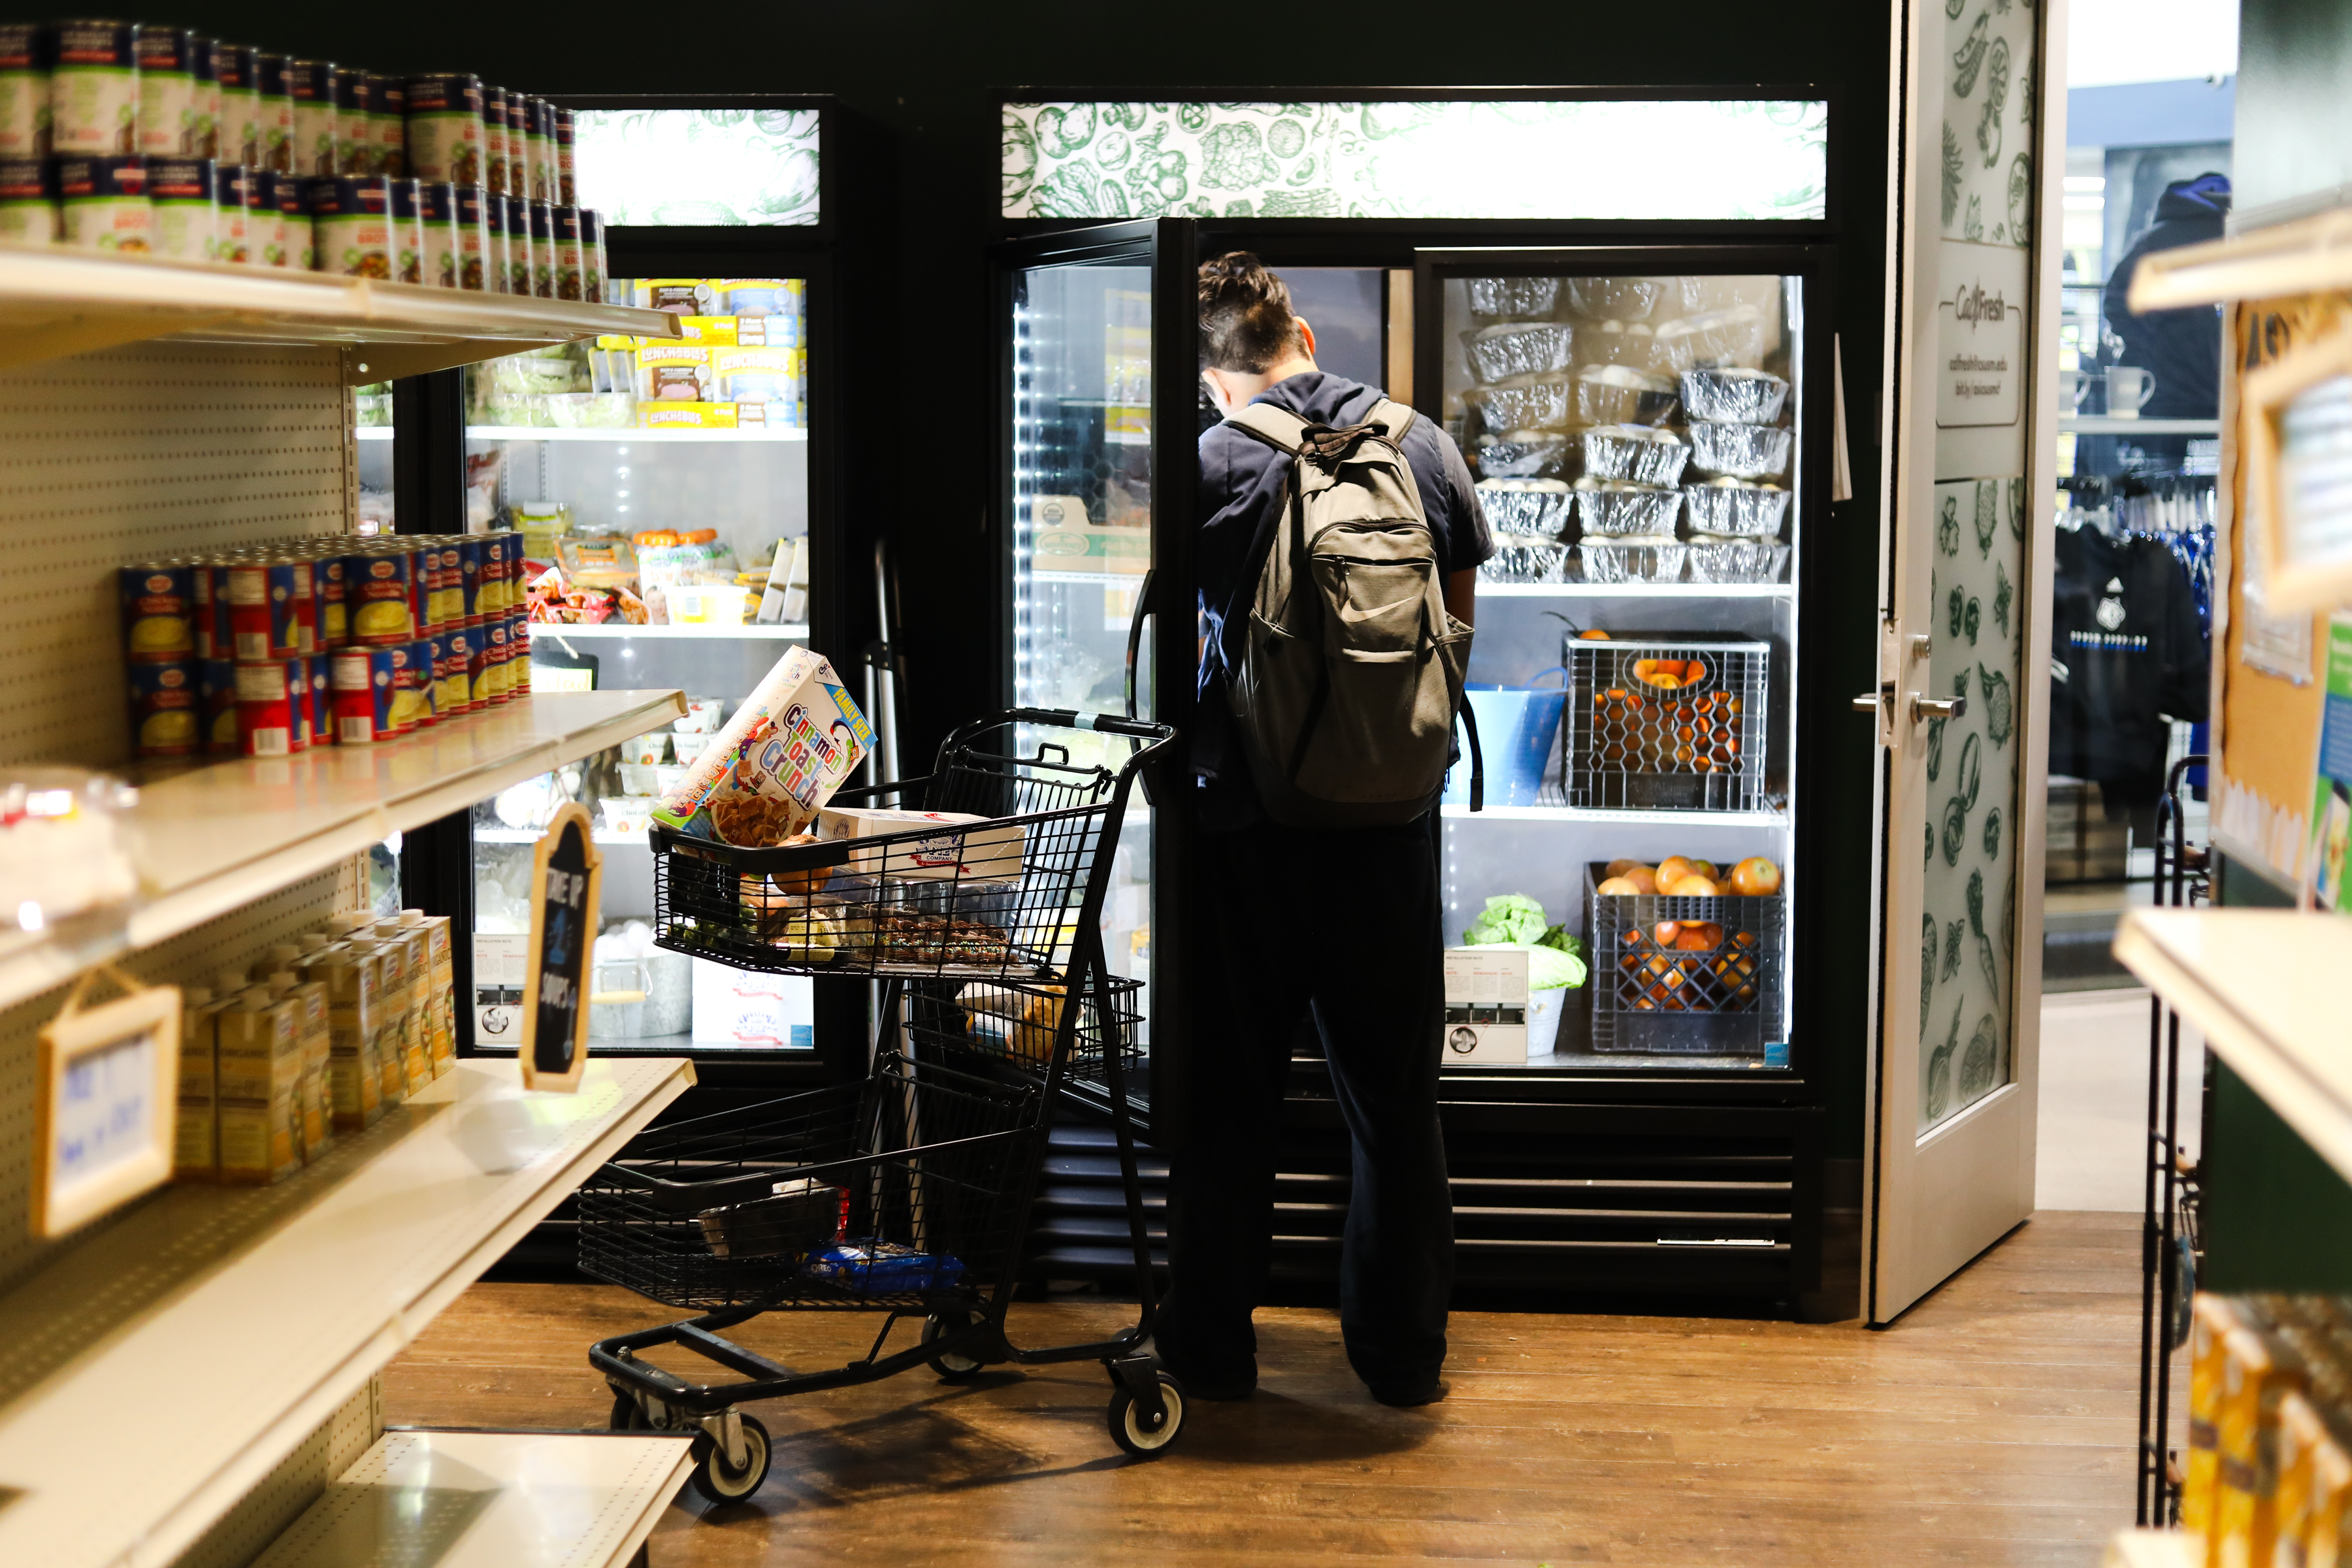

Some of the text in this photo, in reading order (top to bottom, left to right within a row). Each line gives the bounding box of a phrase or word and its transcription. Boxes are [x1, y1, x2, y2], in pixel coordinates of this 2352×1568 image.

[651, 410, 702, 424] LUNCHABLES
[787, 706, 842, 772] Cinnamon
[833, 687, 872, 742] FAMILY SIZE
[762, 740, 819, 809] Crunch
[783, 730, 824, 782] Toast
[811, 1264, 832, 1274] OREO
